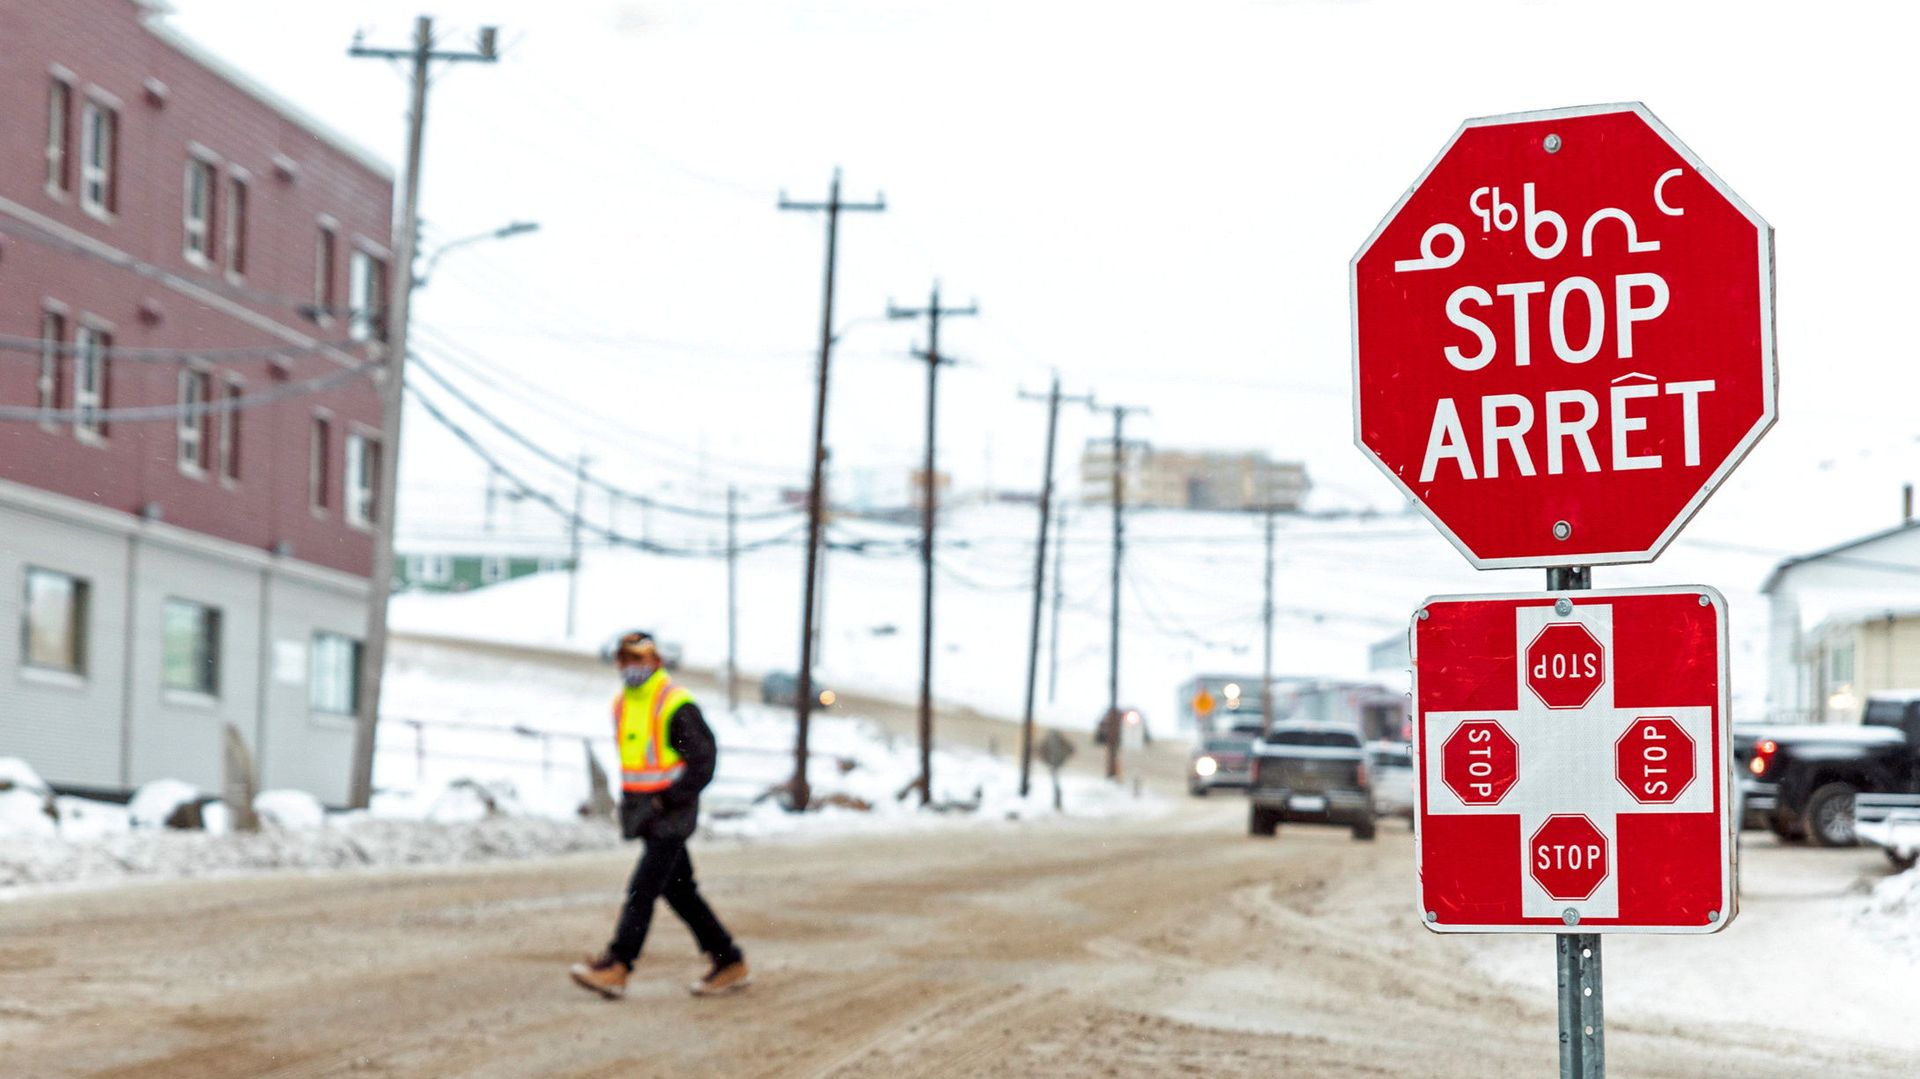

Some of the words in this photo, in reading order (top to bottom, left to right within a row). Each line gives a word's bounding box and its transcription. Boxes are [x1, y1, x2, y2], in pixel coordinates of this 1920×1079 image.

[1443, 273, 1670, 371] STOP
[1418, 372, 1716, 482] ARRÊT
[1533, 652, 1597, 679] STOP
[1468, 729, 1492, 797] STOP
[1643, 725, 1668, 795] STOP
[1537, 844, 1601, 870] STOP
